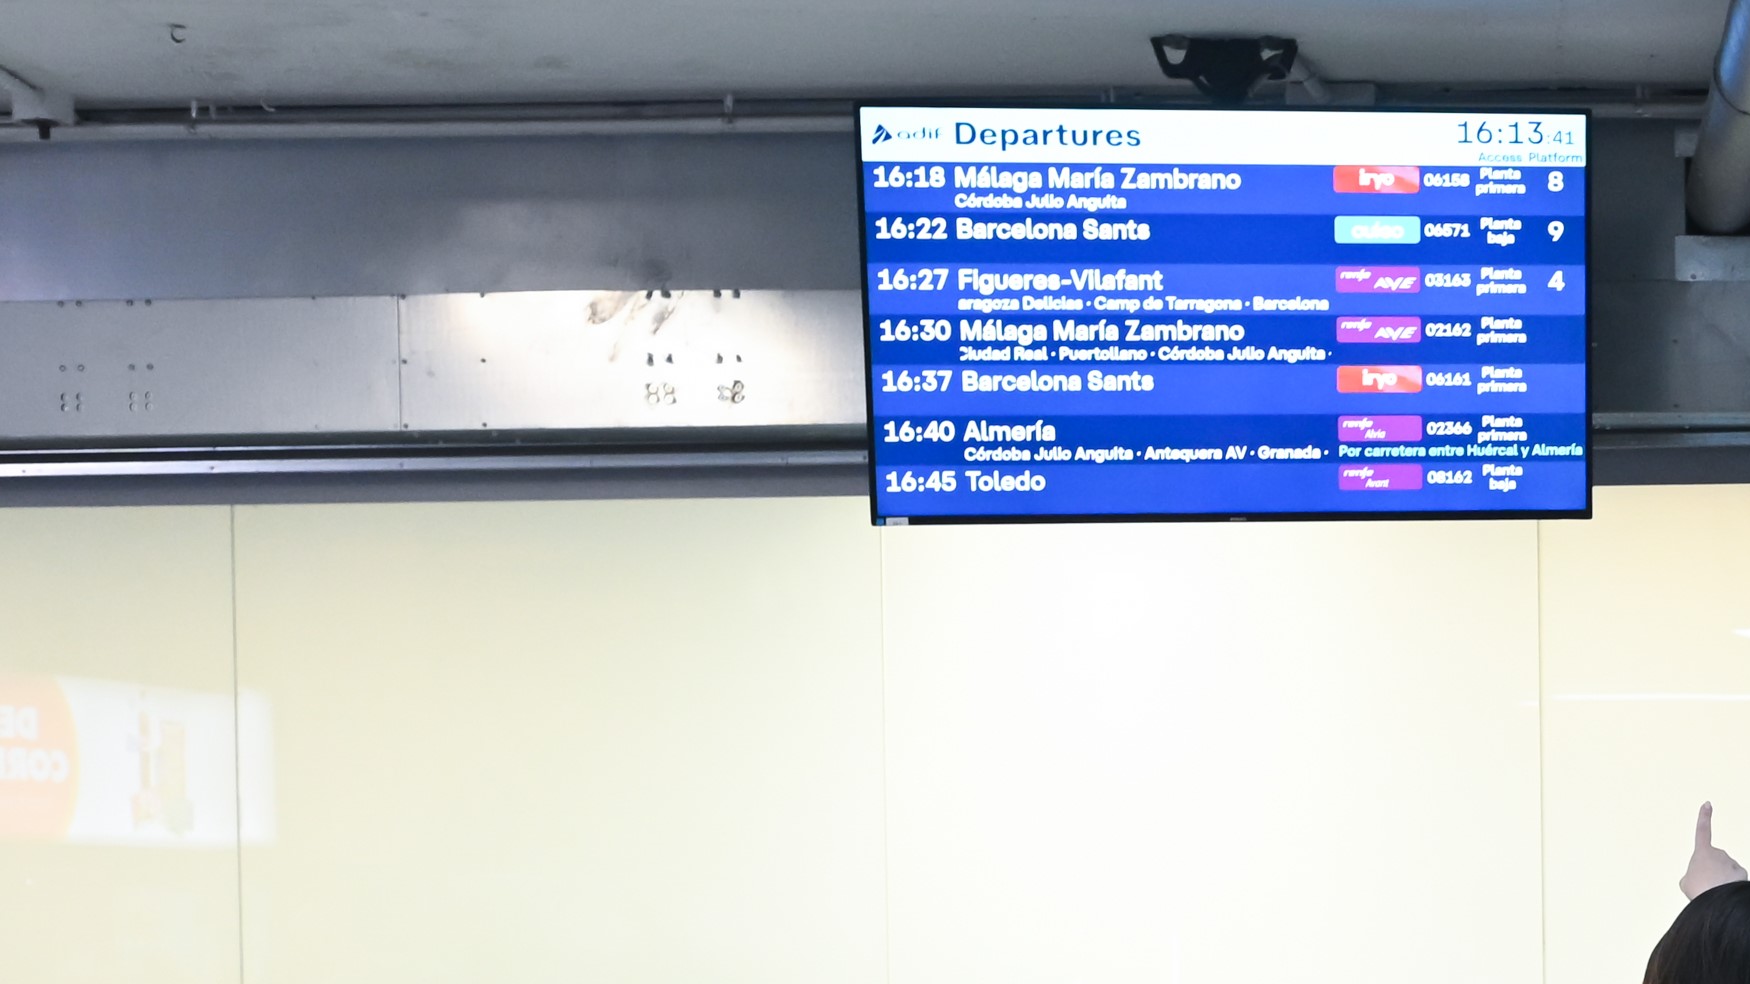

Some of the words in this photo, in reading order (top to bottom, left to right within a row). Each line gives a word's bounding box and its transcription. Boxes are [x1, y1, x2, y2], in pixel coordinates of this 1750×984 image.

[955, 122, 1141, 152] Departures
[1479, 153, 1522, 162] Access
[1529, 152, 1583, 162] Platform
[874, 166, 945, 187] 16:18
[955, 166, 1042, 193] Málaga
[1049, 167, 1114, 188] María
[1121, 168, 1241, 189] Zambrano
[1359, 169, 1394, 190] iryo
[1480, 167, 1521, 179] Planta
[1548, 171, 1563, 191] 8
[1476, 182, 1525, 196] primera
[955, 193, 1022, 208] Córdoba
[1026, 194, 1064, 208] Julio
[1067, 194, 1126, 211] Anguita
[876, 218, 947, 239] 16:22
[957, 218, 1077, 239] Barcelona
[1083, 219, 1150, 239] Sants
[1425, 224, 1470, 237] 06571
[1481, 218, 1521, 229] Planta
[1548, 221, 1564, 241] 9
[1488, 232, 1514, 246] baja
[1425, 273, 1471, 287] 03163
[1481, 267, 1522, 279] Planta
[878, 269, 948, 290] 16:27
[959, 269, 1163, 295] Figueres-Vilafant
[1374, 277, 1416, 290] AVE
[1476, 281, 1526, 295] primera
[1548, 271, 1565, 291] 4
[958, 299, 1019, 313] aragoza
[1023, 296, 1083, 310] Delicias
[1094, 296, 1140, 313] Camp
[1143, 296, 1163, 310] de
[1166, 296, 1242, 313] Tarragona
[1253, 296, 1329, 310] Barcelona
[1426, 323, 1471, 336] 02162
[1481, 317, 1522, 329] Planta
[880, 320, 951, 341] 16:30
[960, 320, 1047, 345] Málaga
[1053, 320, 1118, 341] María
[1125, 320, 1244, 341] Zambrano
[1375, 327, 1417, 340] AVE
[1477, 331, 1526, 345] primera
[1014, 347, 1048, 360] Real
[1059, 347, 1147, 360] Puertollano
[1158, 346, 1224, 360] Córdoba
[1227, 347, 1264, 360] Julio
[1268, 347, 1325, 363] Anguita
[1362, 367, 1397, 389] iryo
[1482, 366, 1522, 378] Planta
[882, 370, 952, 391] 16:37
[962, 370, 1081, 391] Barcelona
[1088, 370, 1154, 391] Sants
[1426, 373, 1471, 386] 06161
[1477, 380, 1527, 394] primera
[1482, 416, 1522, 427] Planta
[884, 421, 955, 442] 16:40
[964, 420, 1055, 441] Almería
[1478, 429, 1527, 443] primera
[964, 447, 1030, 461] Córdoba
[1034, 447, 1071, 460] Julio
[1075, 447, 1133, 463] Anguita
[1145, 447, 1222, 462] Antequera
[1226, 446, 1247, 459] AV
[1258, 445, 1321, 459] Granada
[1339, 445, 1362, 457] Por
[1364, 445, 1426, 457] carretera
[1429, 445, 1464, 456] entre
[1467, 444, 1518, 456] Huércal
[1521, 447, 1529, 458] y
[1532, 443, 1583, 455] Almería
[1483, 464, 1522, 476] Planta
[886, 471, 956, 492] 16:45
[965, 470, 1045, 491] Toledo
[1490, 478, 1516, 492] baja
